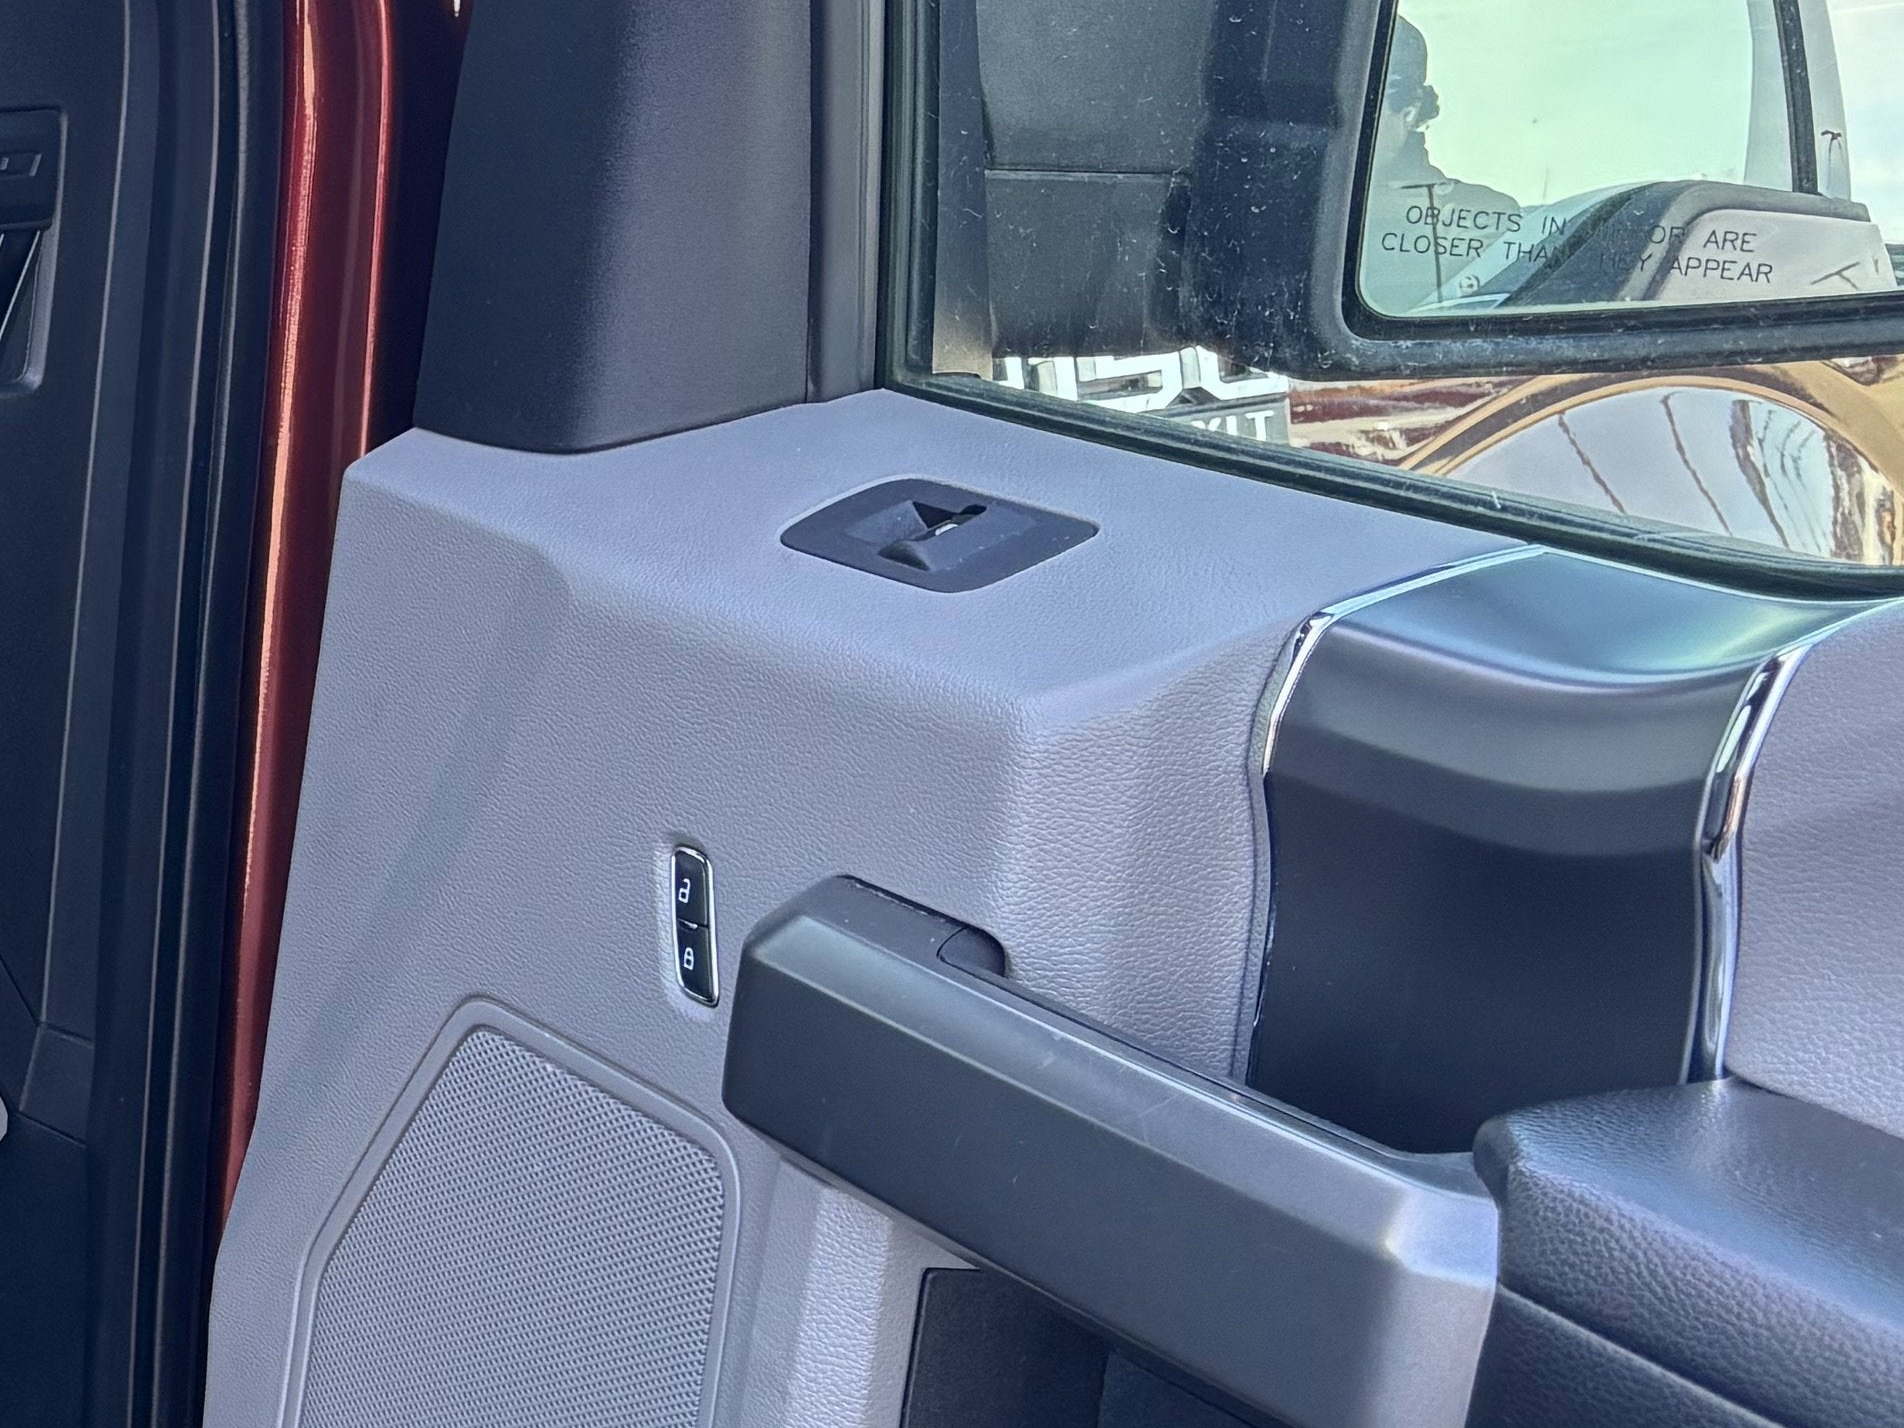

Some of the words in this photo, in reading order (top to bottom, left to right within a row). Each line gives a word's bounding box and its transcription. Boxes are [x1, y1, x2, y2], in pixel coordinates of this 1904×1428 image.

[1405, 204, 1522, 233] OBJECTS
[1542, 214, 1568, 236] IN
[1703, 229, 1757, 253] ARE
[1381, 232, 1485, 259] CLOSER
[1504, 241, 1571, 264] THAN
[1592, 250, 1653, 273] HEY
[1669, 257, 1774, 284] APPEAR
